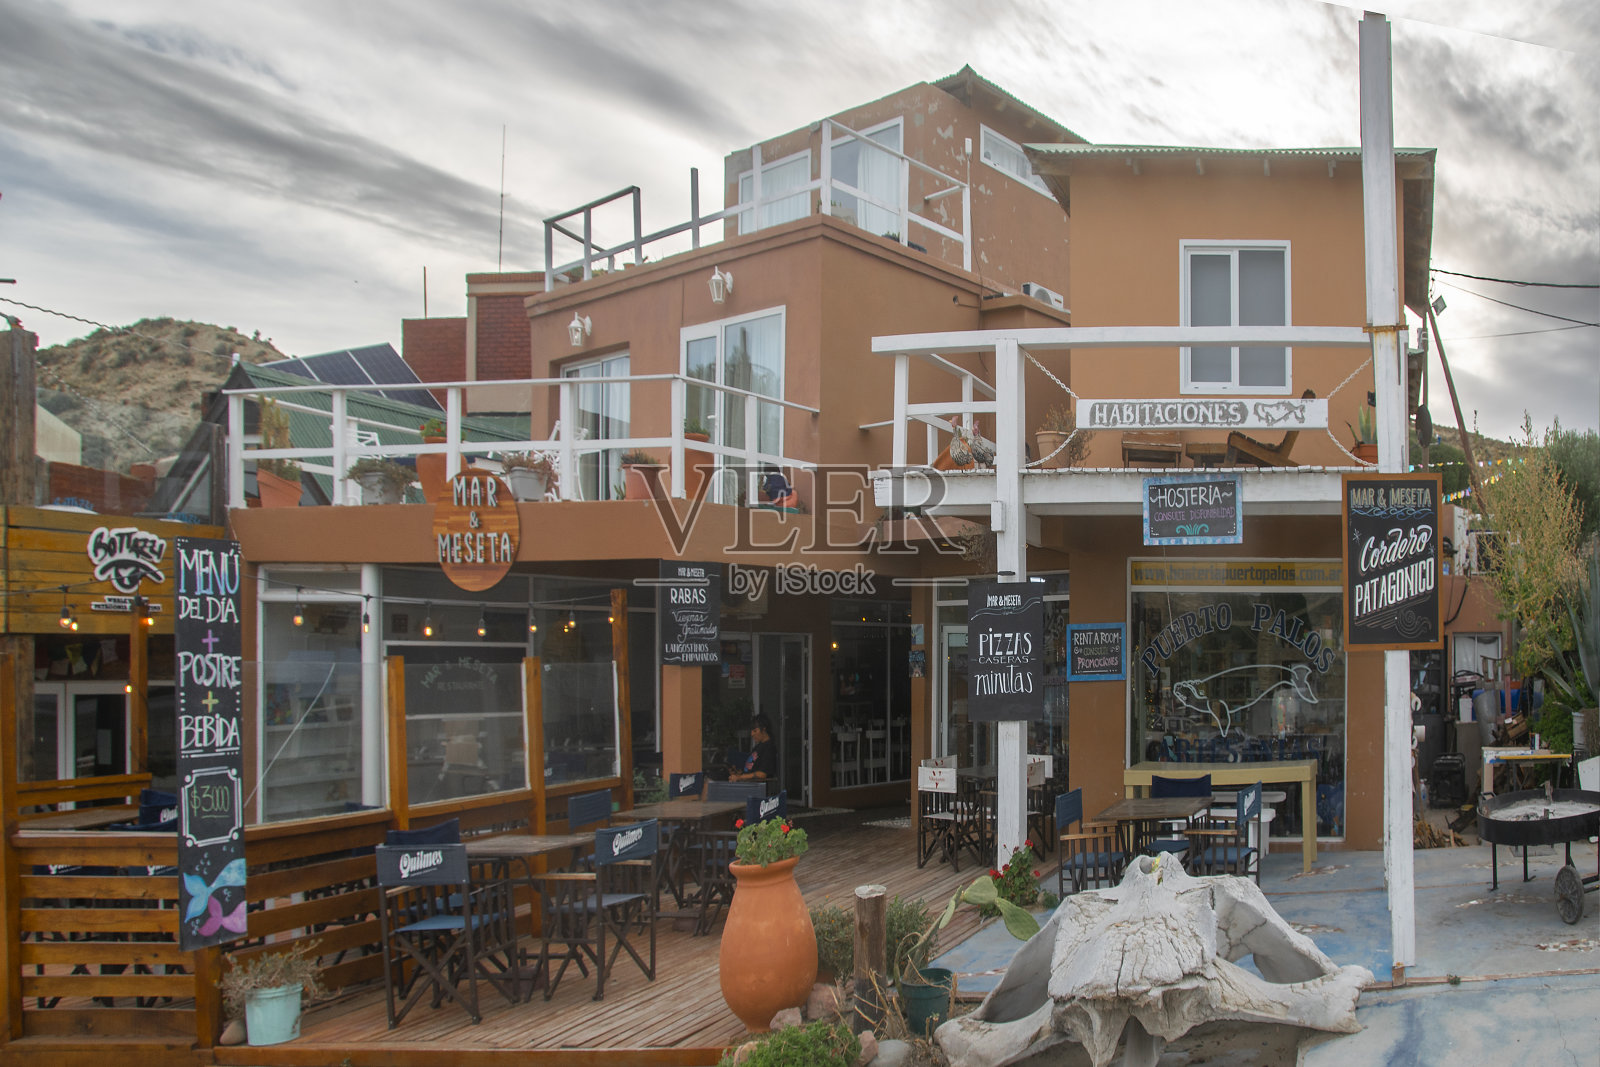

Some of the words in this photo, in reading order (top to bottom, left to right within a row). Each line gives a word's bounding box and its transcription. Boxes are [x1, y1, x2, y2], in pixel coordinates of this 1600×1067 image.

[1094, 402, 1242, 425] HABITACIONES
[453, 476, 498, 507] MAR
[1351, 487, 1375, 508] MAR
[1377, 487, 1387, 508] &
[1389, 487, 1432, 508] MESETA
[469, 510, 480, 528] &
[1153, 510, 1186, 522] CONSULTE
[437, 532, 512, 563] MESETA
[1360, 524, 1433, 573] Cordero
[179, 548, 241, 596] MENÚ
[1134, 565, 1342, 584] www.hosteriapuertopalos.com.ar
[670, 588, 706, 604] RABAS
[1355, 557, 1435, 617] PATAGONICO
[178, 595, 204, 619] DEL
[206, 597, 240, 623] DÍA
[987, 594, 998, 607] MAR
[999, 595, 1003, 607] &
[1004, 594, 1022, 606] MESETA
[665, 643, 709, 653] LANGOSTINOS
[1074, 632, 1093, 645] RENT
[1094, 632, 1099, 645] A
[1100, 632, 1119, 645] ROOM
[1140, 602, 1232, 678] PUERTO
[1251, 603, 1336, 674] PALOS
[177, 651, 242, 688] POSTRE
[978, 656, 1029, 664] CASERAS
[974, 664, 1033, 696] minutas
[399, 850, 443, 879] Quilmes
